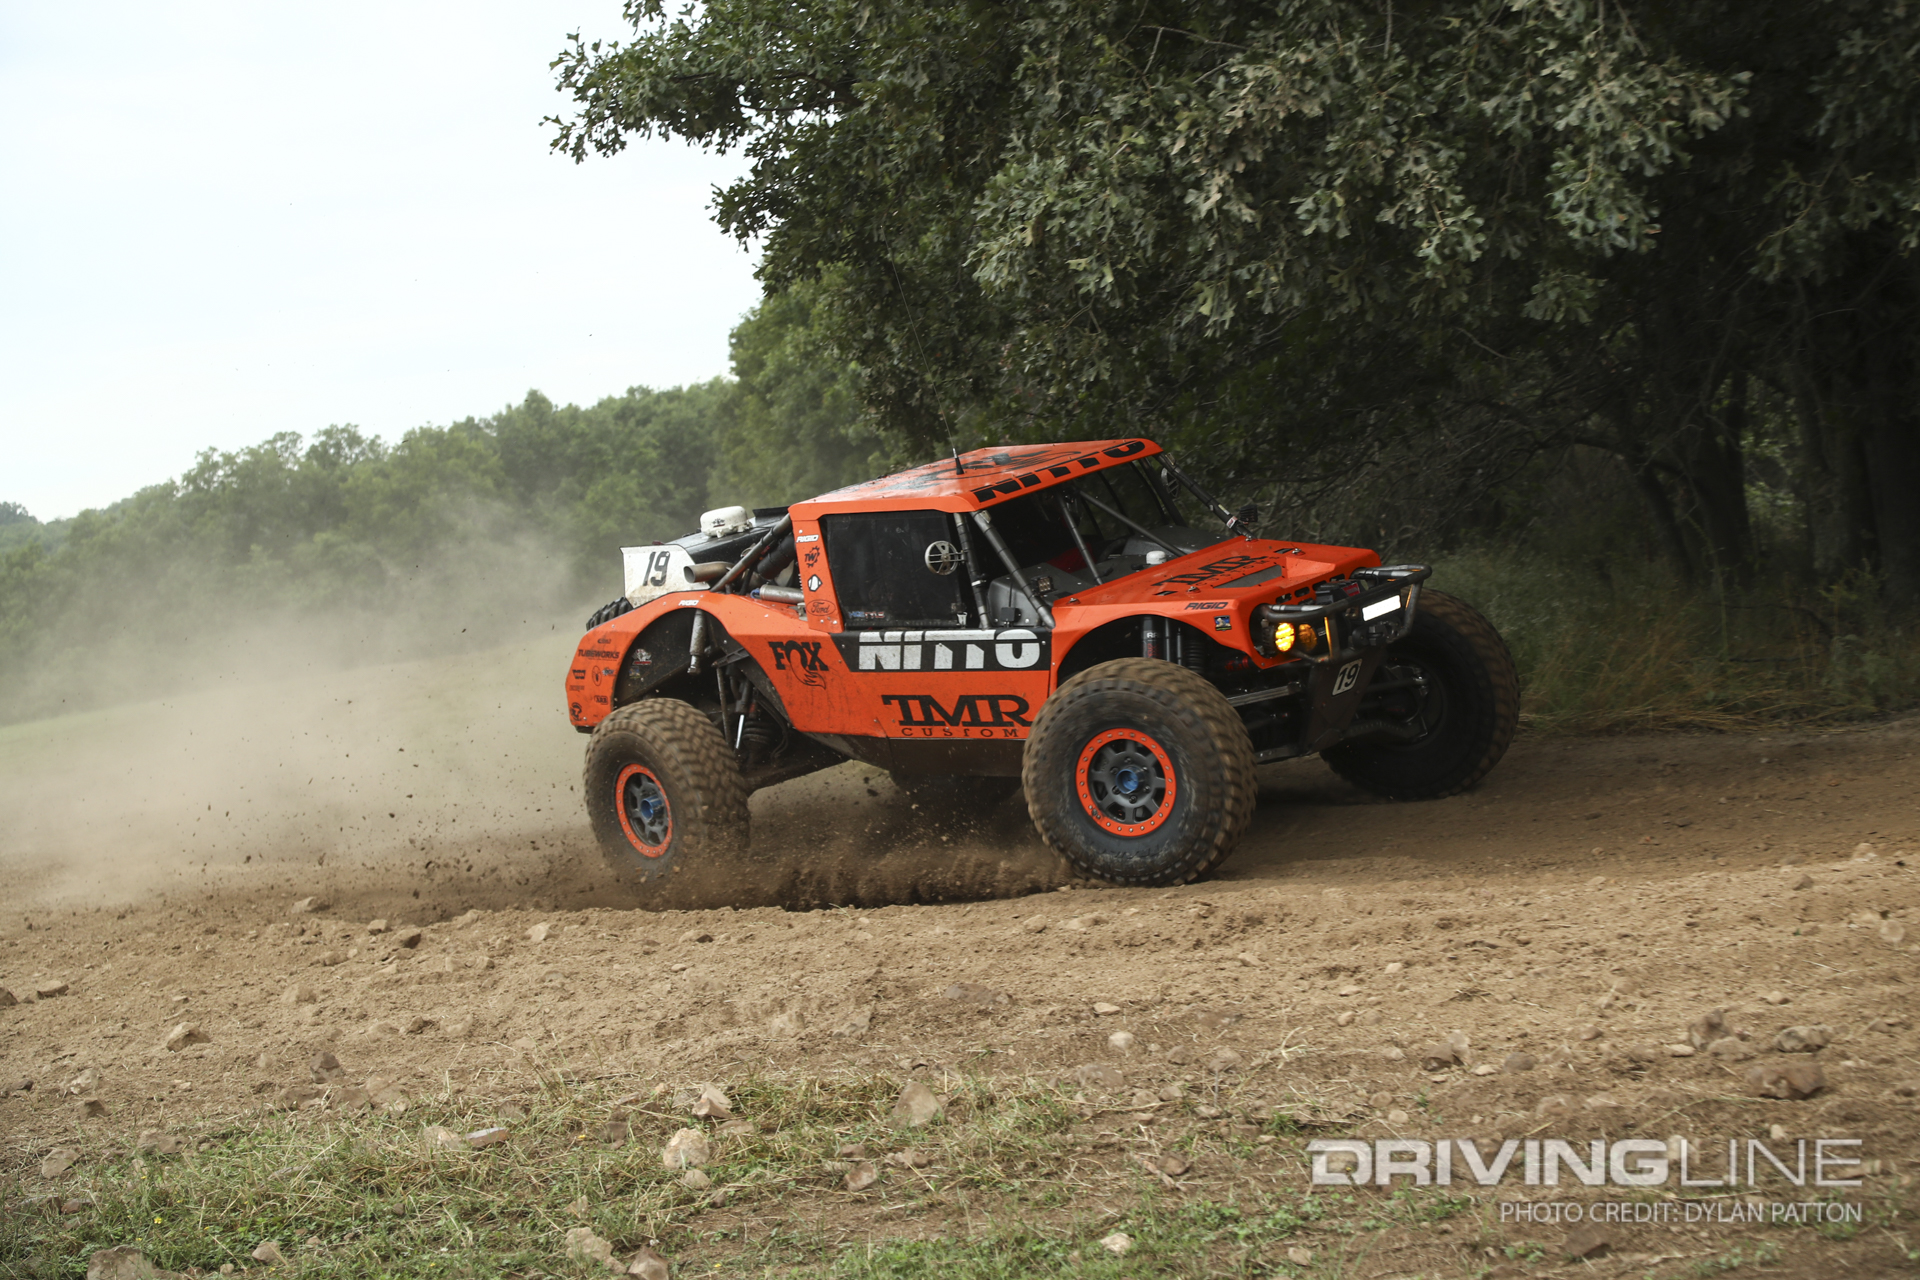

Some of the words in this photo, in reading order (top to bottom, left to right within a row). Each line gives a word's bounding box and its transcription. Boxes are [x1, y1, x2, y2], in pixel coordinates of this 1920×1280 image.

[970, 440, 1146, 503] NITTO
[642, 551, 671, 587] 19
[1151, 555, 1268, 586] TMR
[811, 602, 831, 614] Ford
[1184, 601, 1229, 610] RIGID
[577, 649, 620, 659] TUBEWORKS
[768, 640, 829, 673] FOX
[858, 629, 1041, 670] NITTO
[1337, 663, 1360, 690] 19
[881, 694, 1032, 728] TMR
